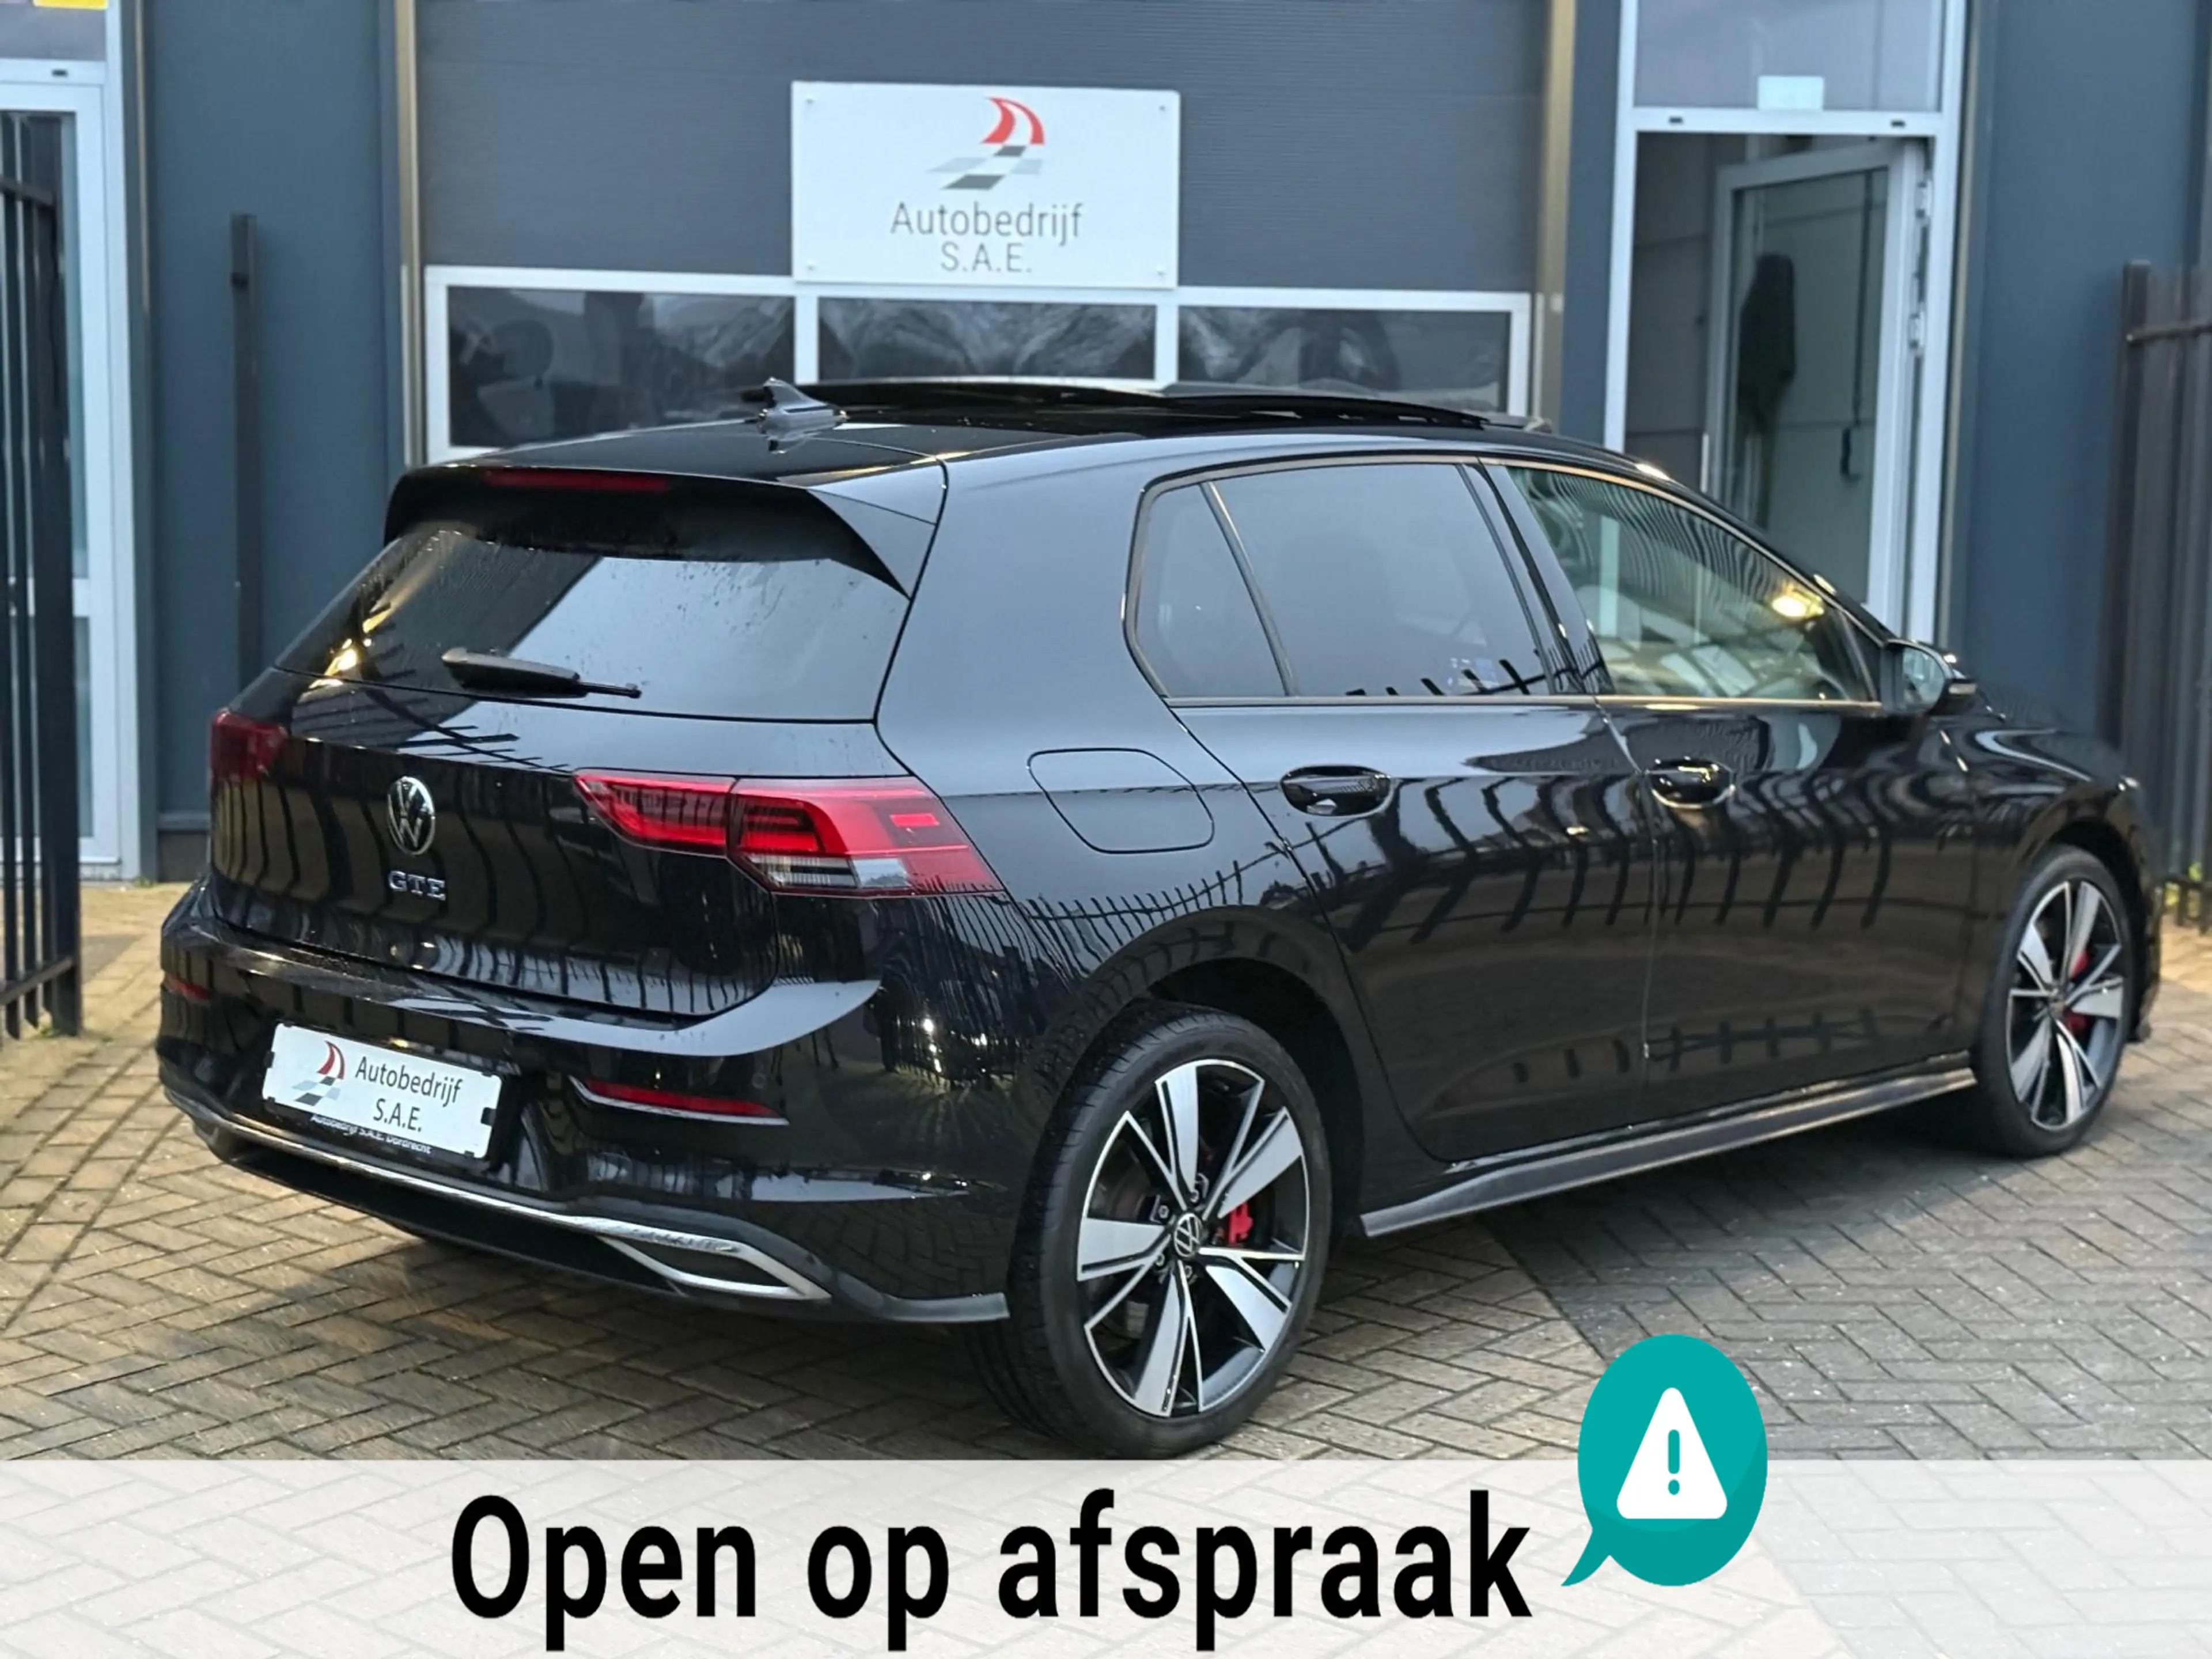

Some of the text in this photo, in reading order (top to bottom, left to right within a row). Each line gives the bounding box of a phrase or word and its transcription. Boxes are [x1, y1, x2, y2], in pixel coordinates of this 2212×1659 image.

[890, 201, 1084, 247] Autobedrijf
[940, 241, 1032, 273] S.A.E.
[388, 870, 446, 901] GTE
[355, 1056, 463, 1107] Autobedrijf
[373, 1098, 422, 1132] S.A.E.
